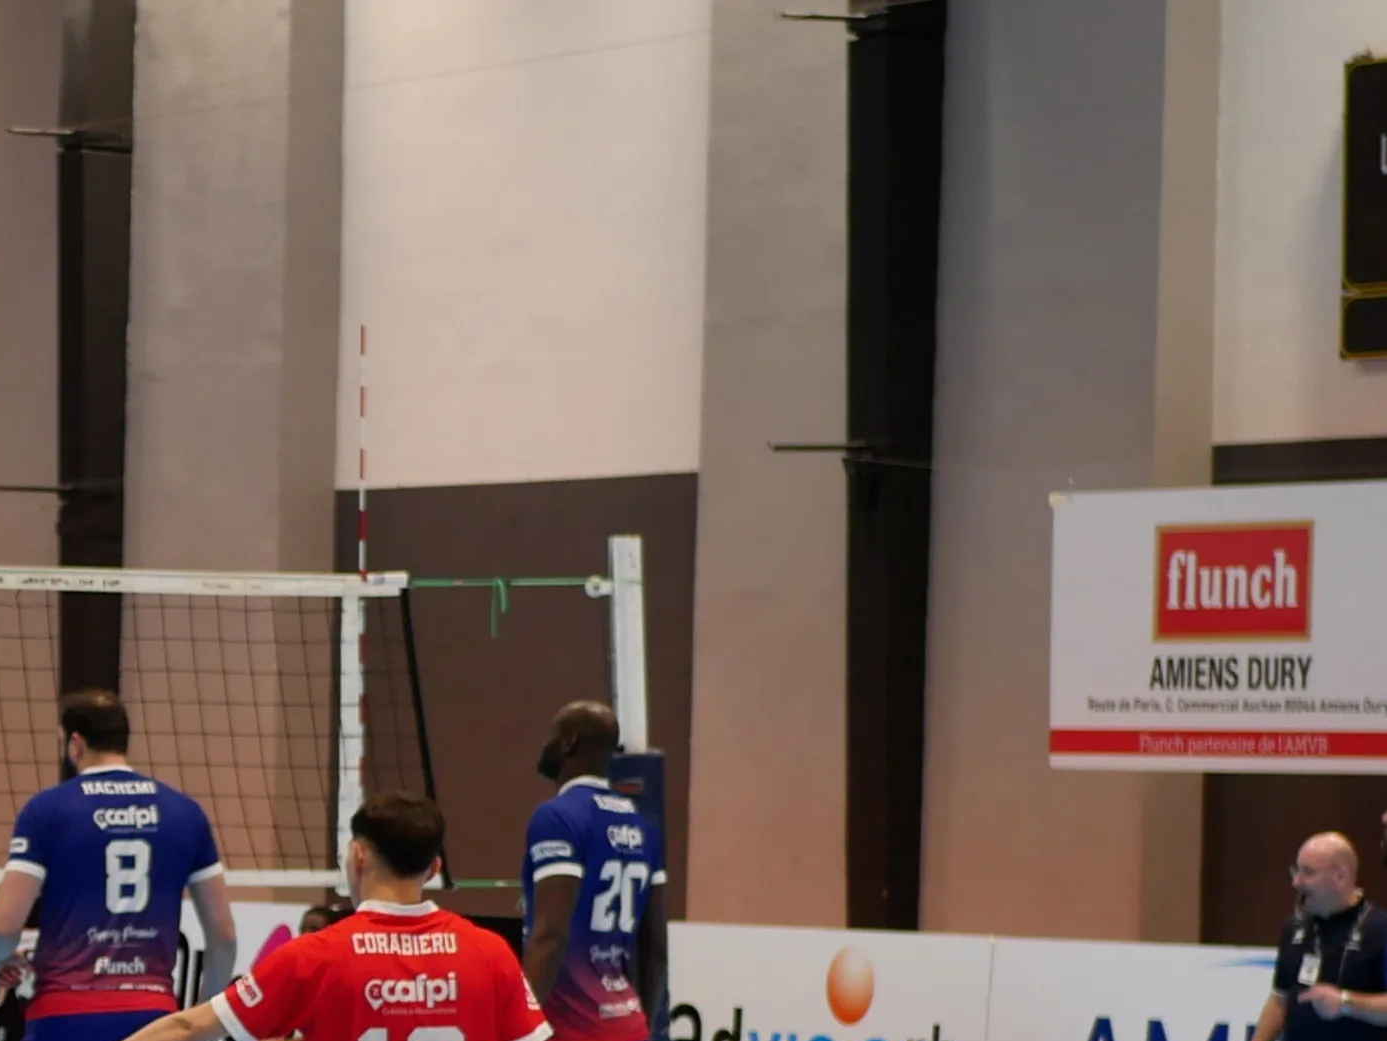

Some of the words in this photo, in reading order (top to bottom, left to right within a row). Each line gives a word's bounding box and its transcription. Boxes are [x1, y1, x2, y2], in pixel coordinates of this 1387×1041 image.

[1166, 547, 1298, 611] flunch
[1149, 655, 1240, 691] AMIENS
[1247, 654, 1314, 691] DURY
[1139, 733, 1185, 752] Flunch
[1187, 735, 1255, 757] partenaire
[1257, 735, 1276, 754] de
[105, 838, 152, 914] 8
